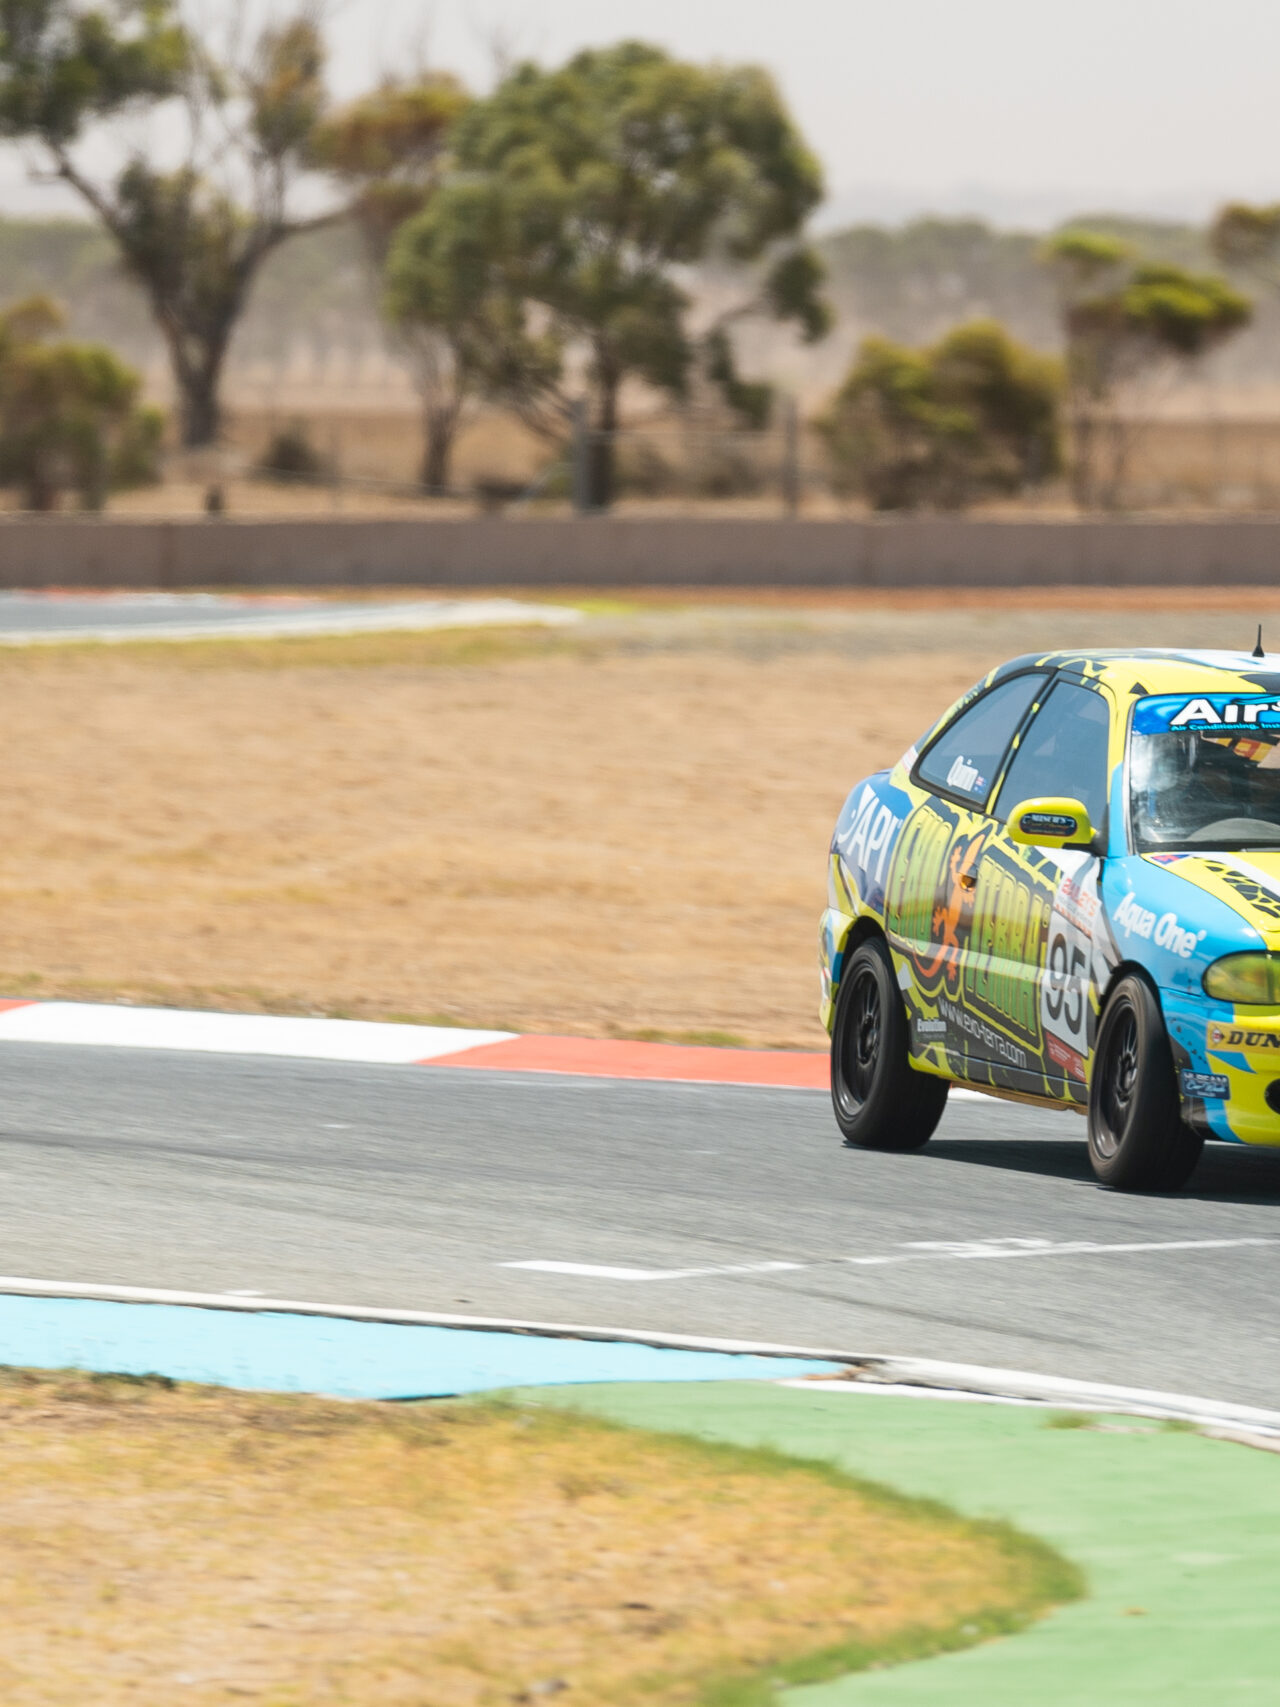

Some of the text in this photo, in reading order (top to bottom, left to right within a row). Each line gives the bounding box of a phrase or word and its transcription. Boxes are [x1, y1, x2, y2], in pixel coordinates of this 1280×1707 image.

[1170, 698, 1269, 726] Air
[1113, 891, 1157, 939] Aqua
[1153, 912, 1199, 958] One
[1045, 932, 1087, 1035] 95
